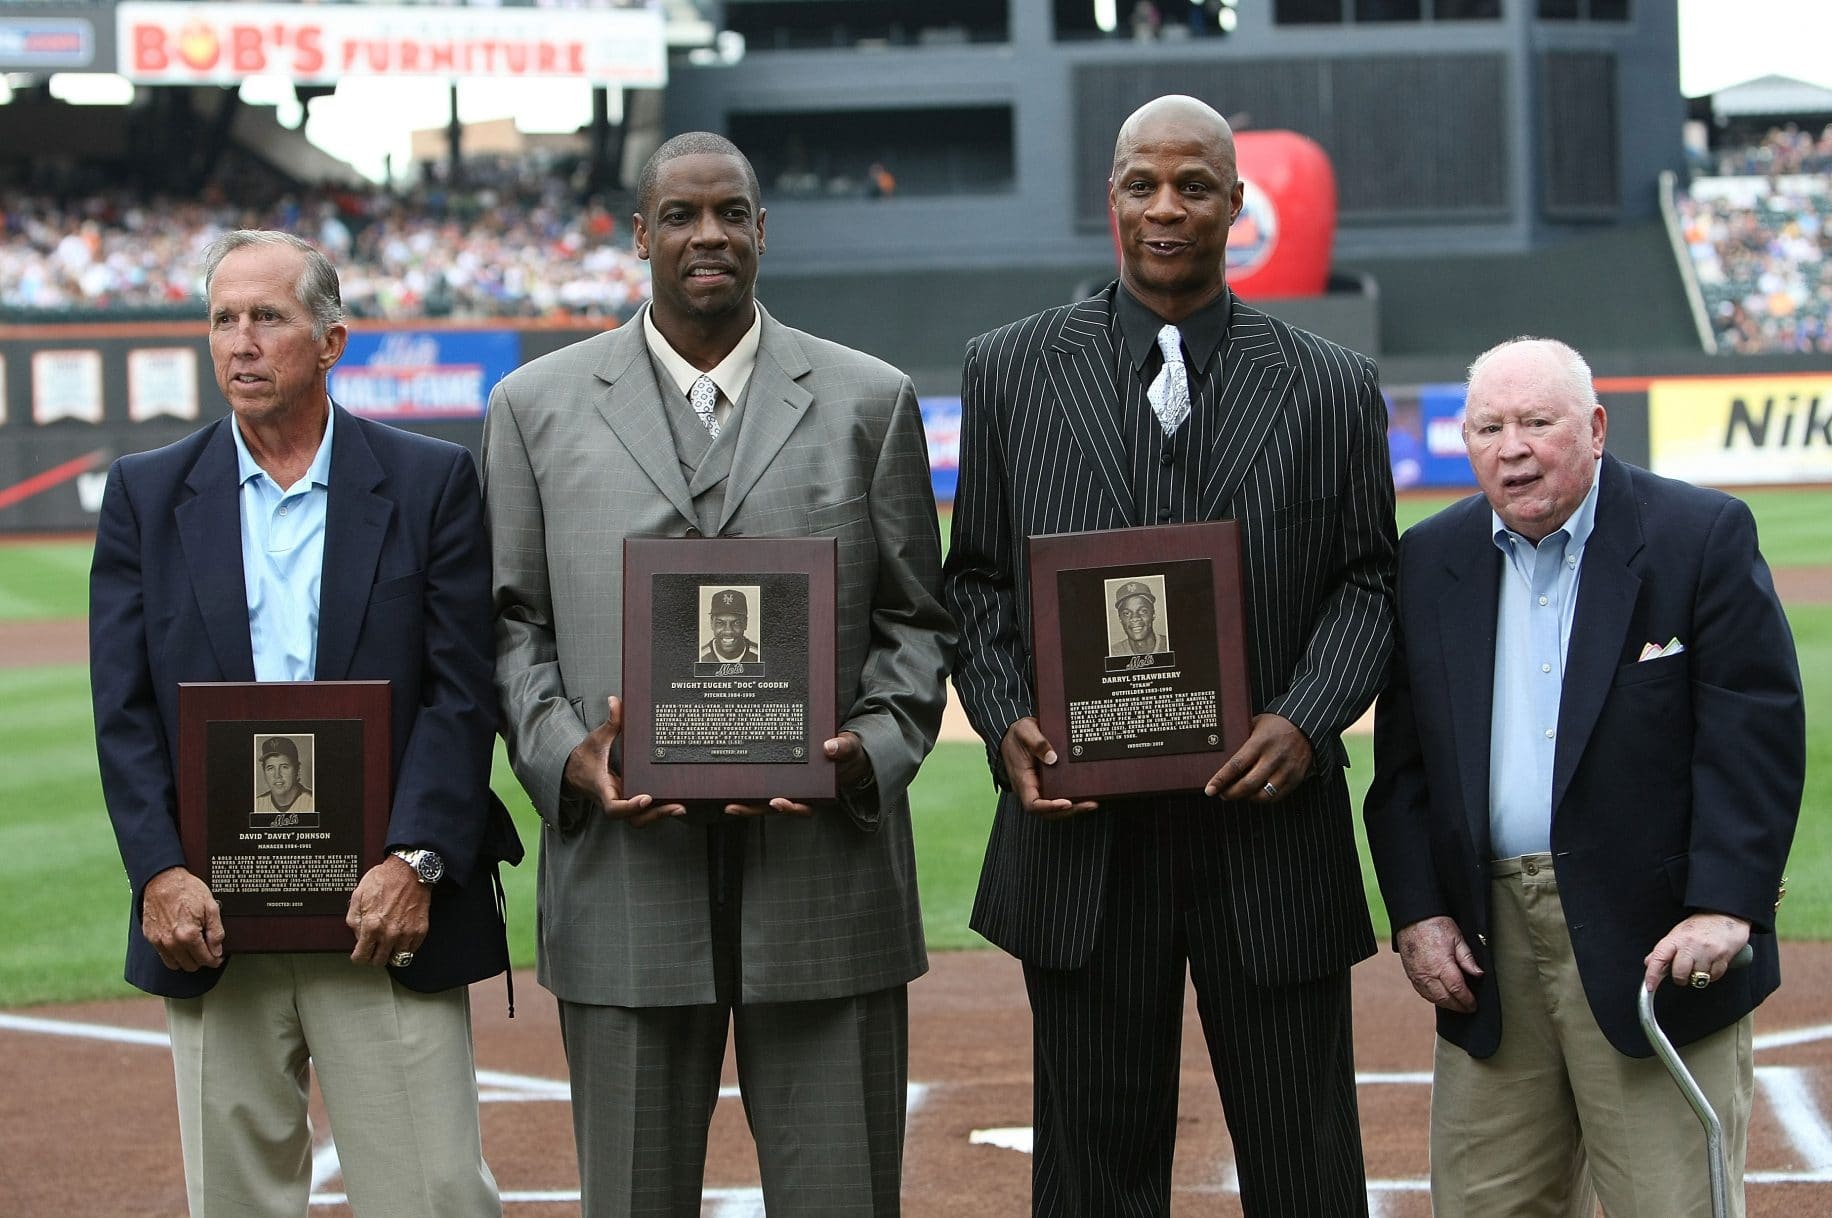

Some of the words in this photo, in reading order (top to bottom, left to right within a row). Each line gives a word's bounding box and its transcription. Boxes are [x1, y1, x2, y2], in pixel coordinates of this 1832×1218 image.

[342, 39, 586, 74] FURNITURE
[716, 662, 744, 676] Mets
[1126, 654, 1155, 670] Mets
[1132, 672, 1181, 681] STRAWBERRY
